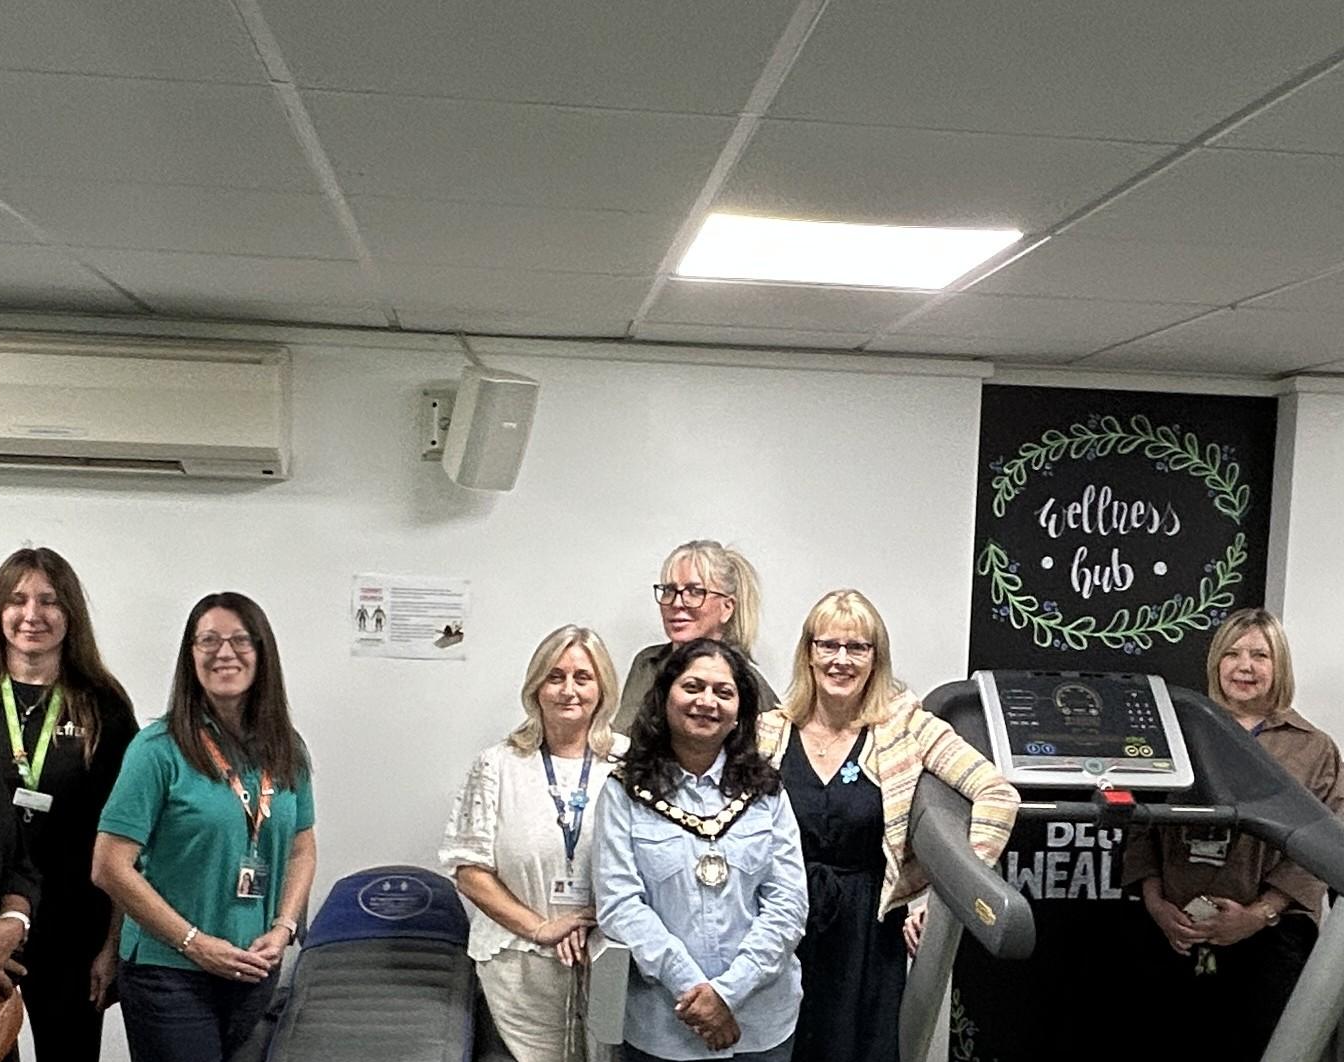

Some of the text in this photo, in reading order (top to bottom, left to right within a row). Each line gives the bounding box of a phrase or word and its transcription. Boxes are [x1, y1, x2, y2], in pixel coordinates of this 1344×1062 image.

[1034, 484, 1181, 538] wellness
[1070, 546, 1134, 599] hub
[1007, 850, 1141, 901] WEAL
